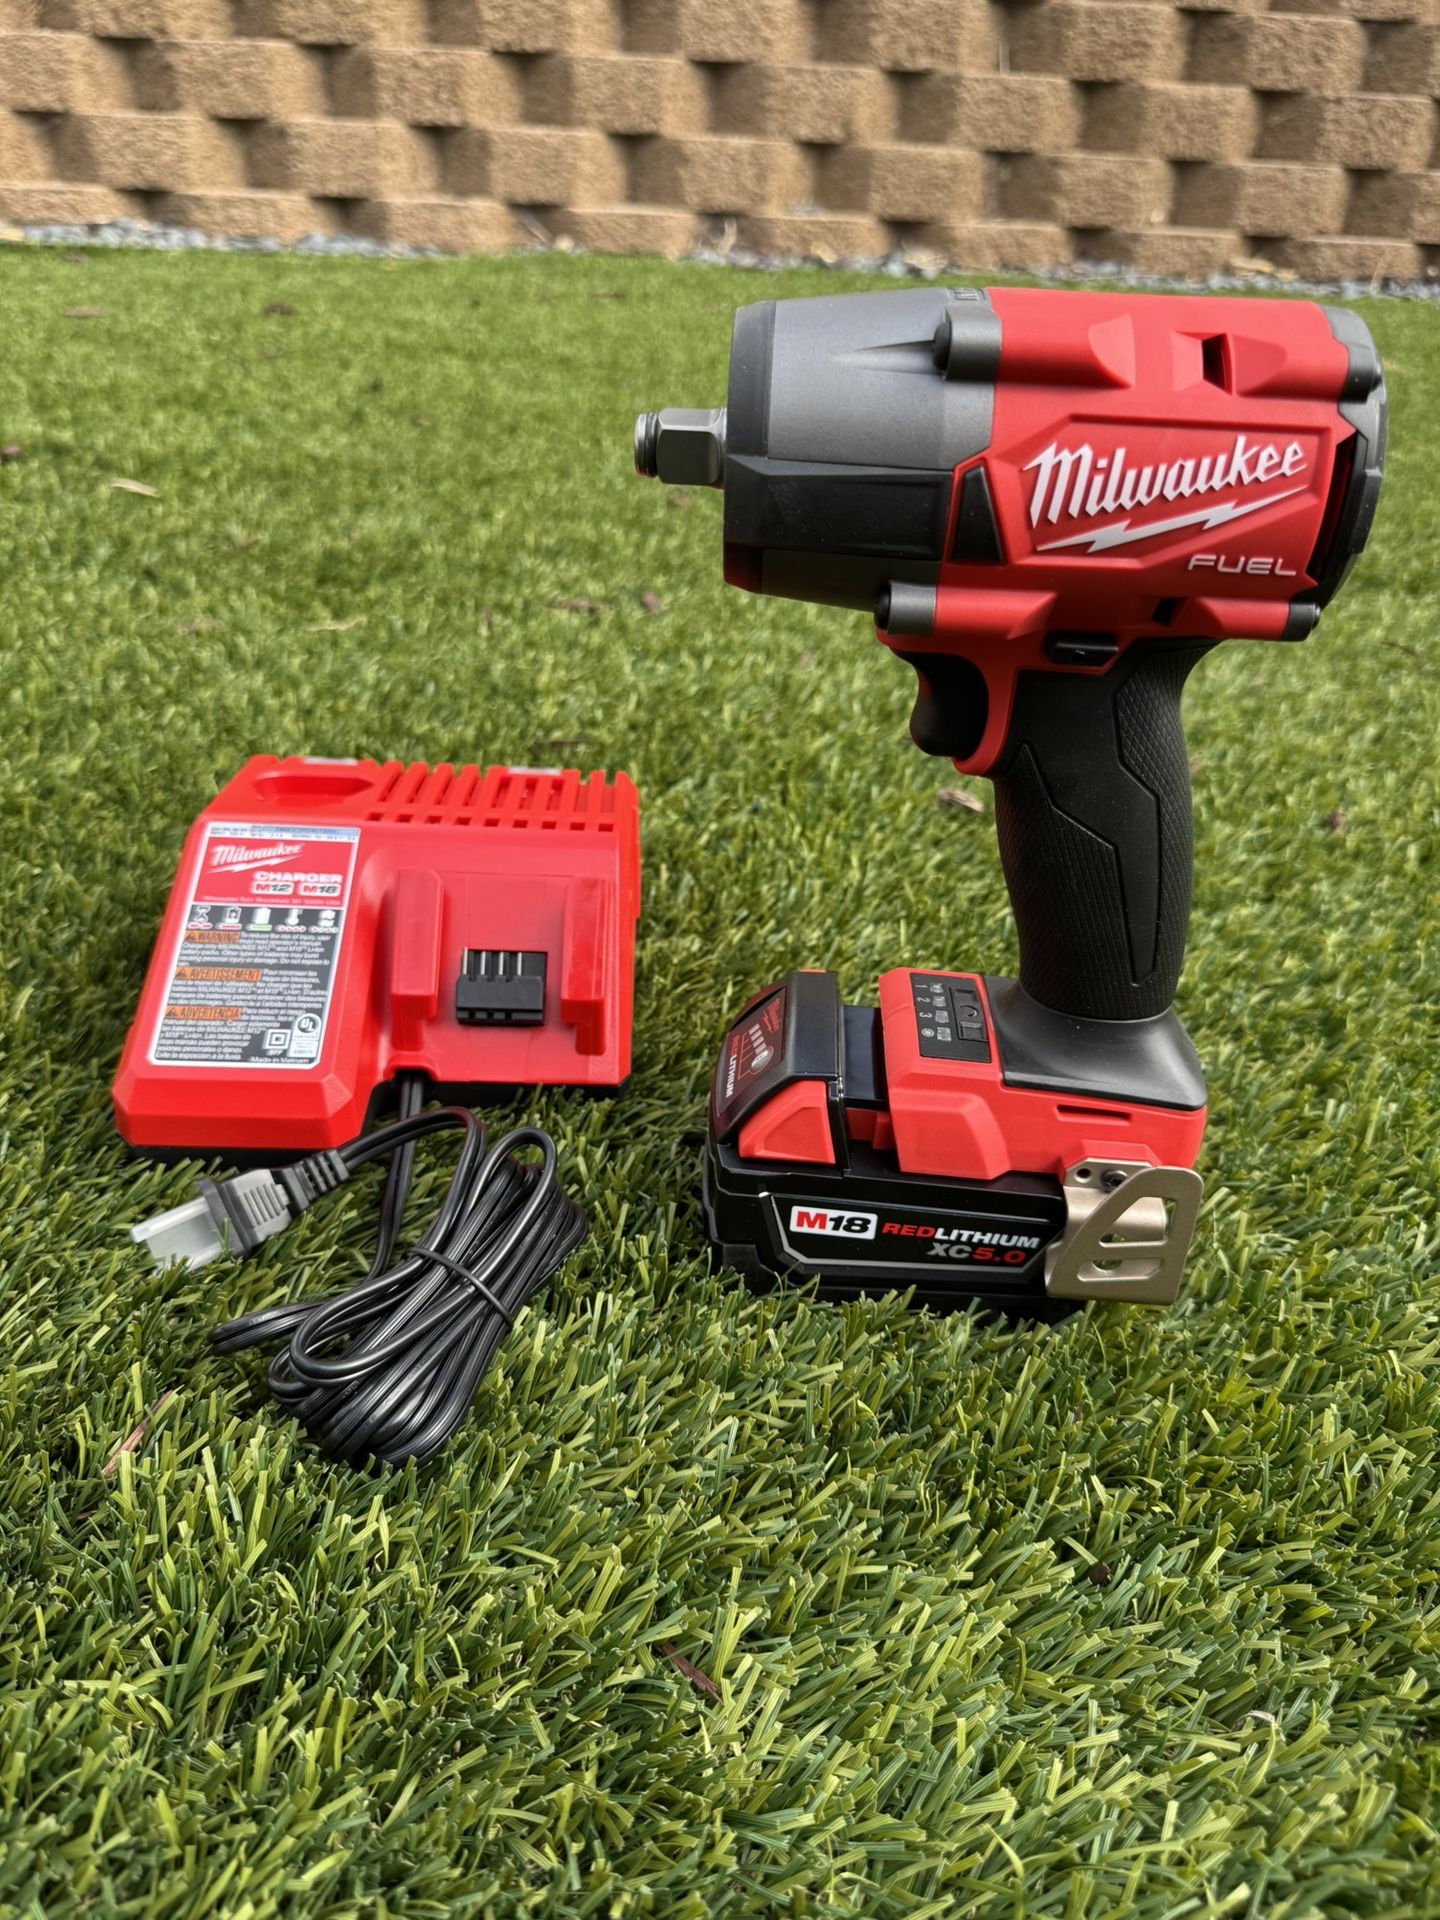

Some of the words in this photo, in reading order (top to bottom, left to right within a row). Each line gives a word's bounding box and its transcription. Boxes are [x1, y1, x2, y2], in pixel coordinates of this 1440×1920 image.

[1022, 434, 1307, 529] Milwaukee
[1187, 554, 1297, 576] FUEL
[211, 842, 303, 866] Milwaukee
[253, 870, 343, 883] CHARGER
[255, 884, 292, 893] M12
[303, 884, 338, 894] M18
[198, 931, 239, 943] WARNING
[180, 1006, 239, 1019] ADVERTENCIA
[795, 1210, 872, 1234] M18
[881, 1222, 1041, 1249] REDLITHIUM
[926, 1241, 1026, 1264] XC5.0
